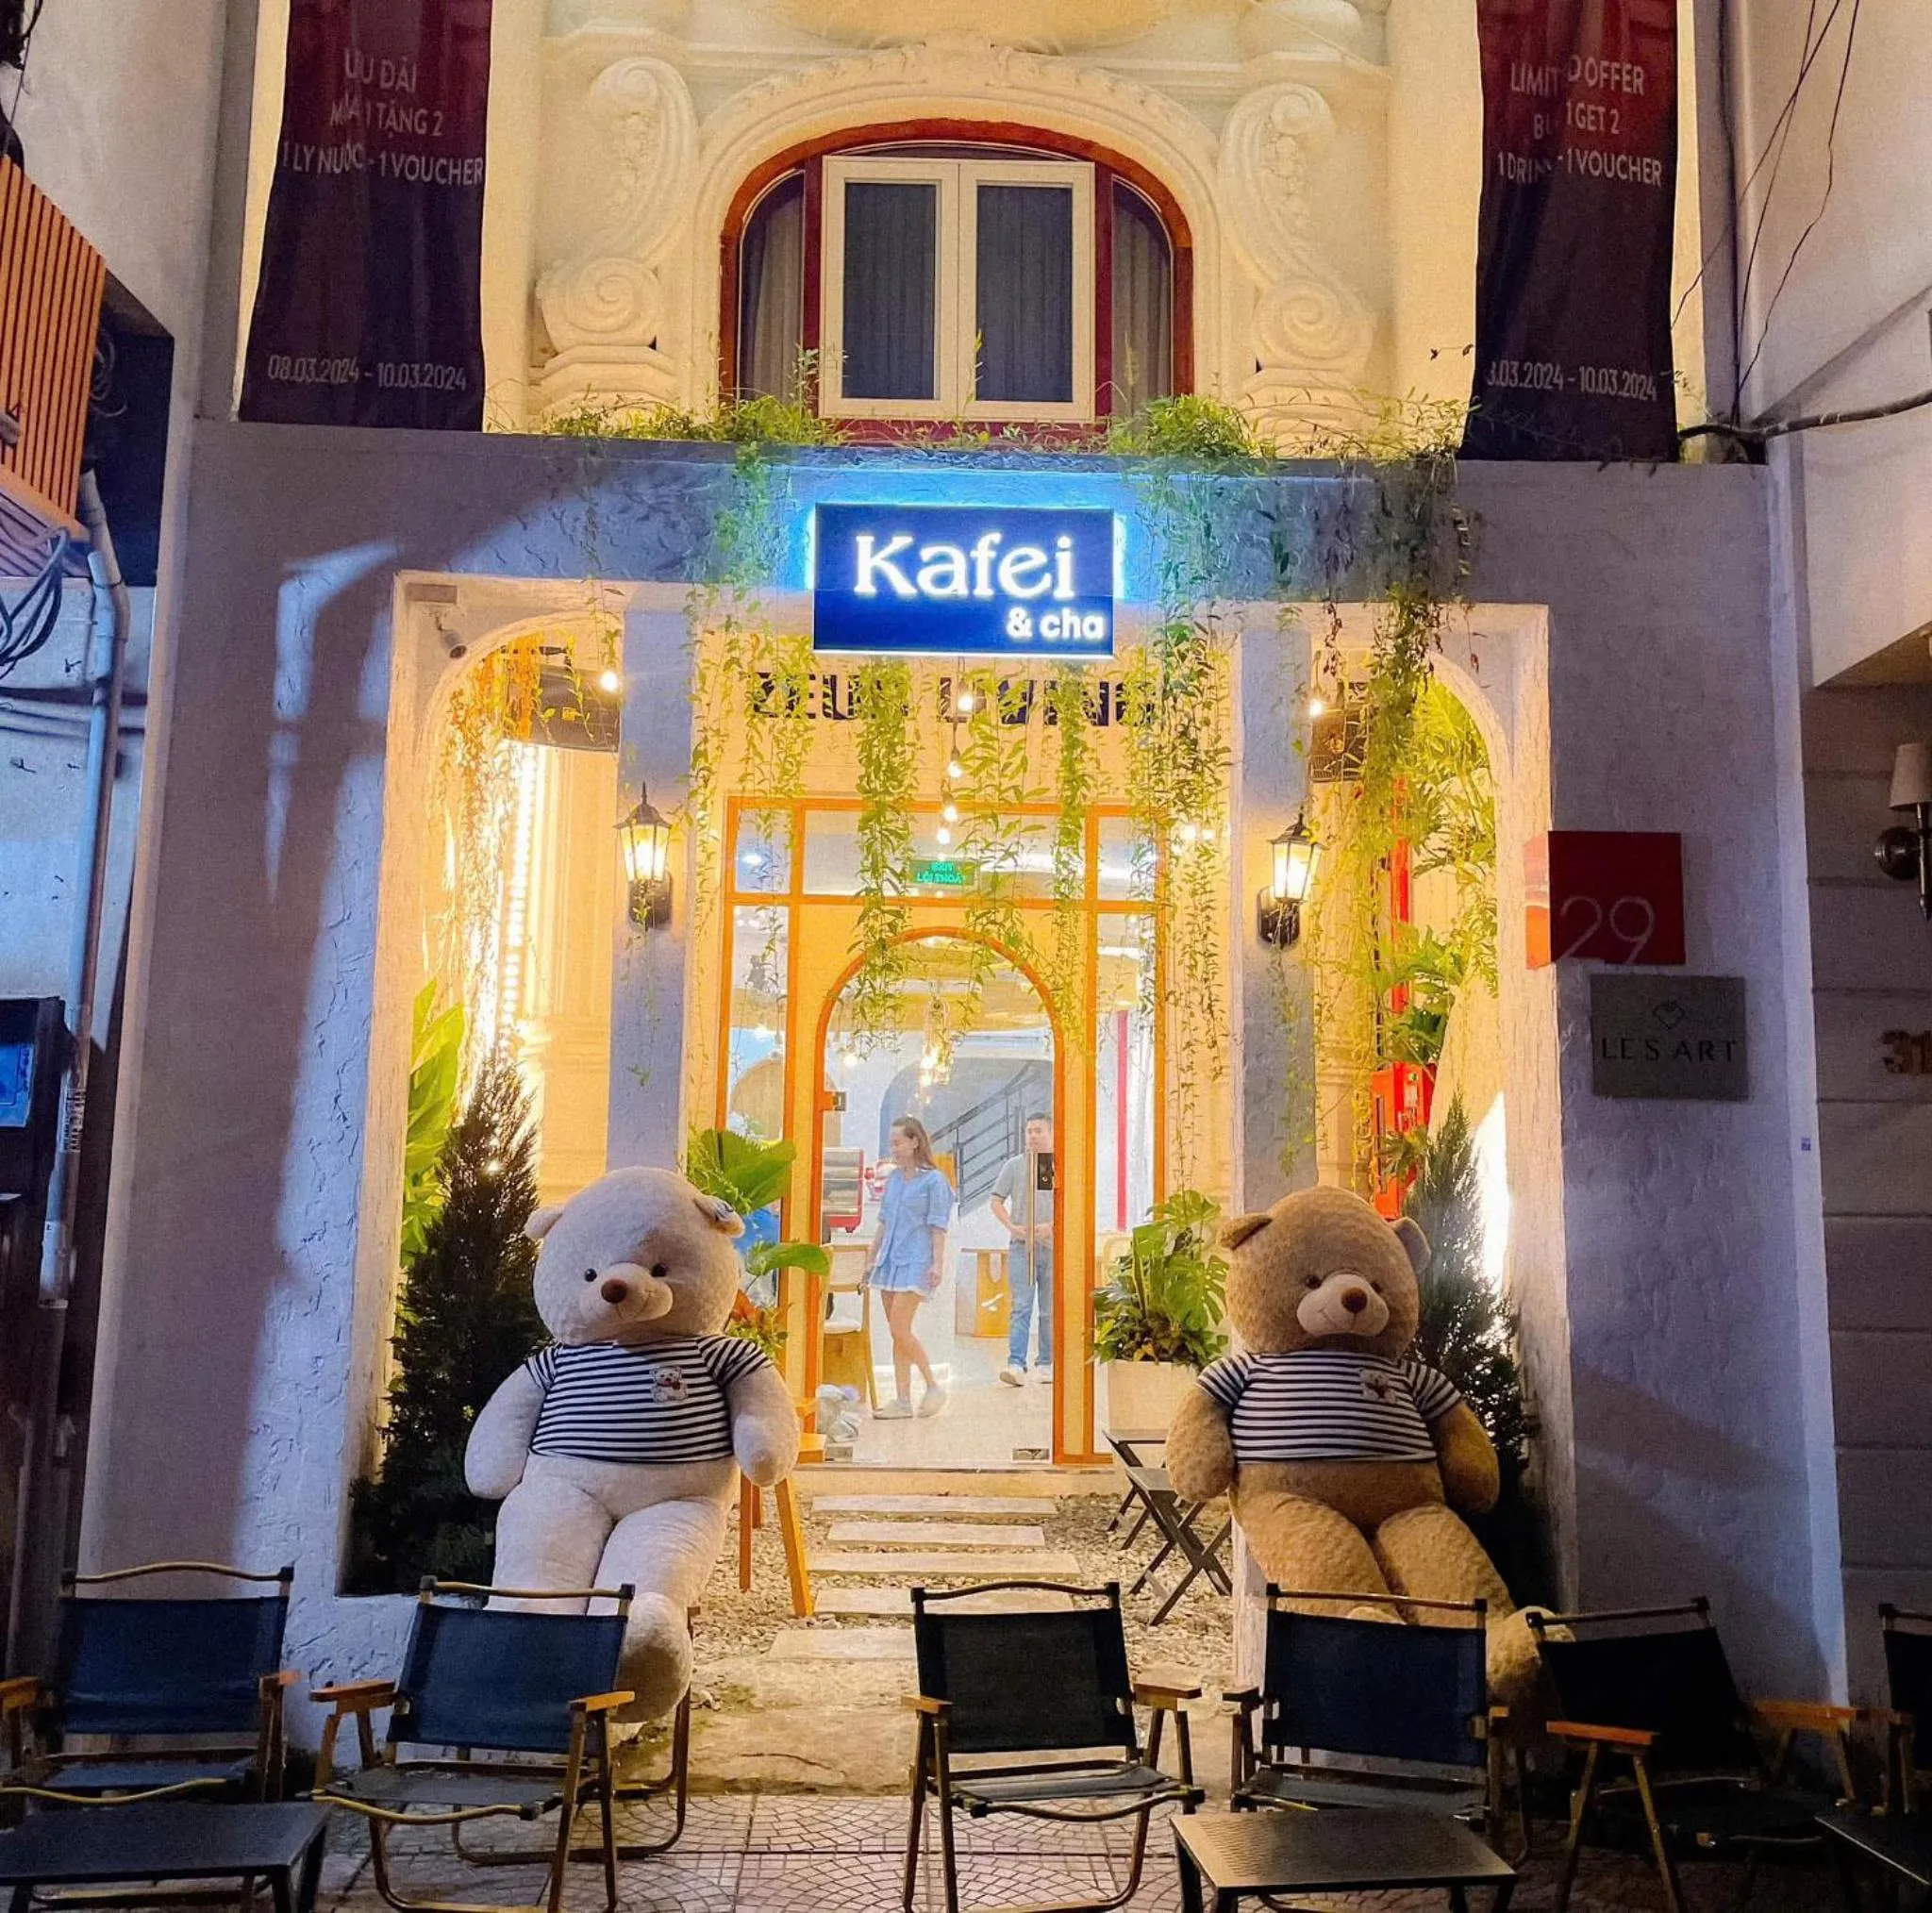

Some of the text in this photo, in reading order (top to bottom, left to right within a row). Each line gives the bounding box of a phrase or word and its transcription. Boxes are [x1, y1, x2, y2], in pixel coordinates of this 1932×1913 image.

[1510, 54, 1644, 96] LIMITD OFFER
[432, 110, 443, 137] 2
[1566, 99, 1572, 125] 1
[1574, 101, 1606, 131] GET
[1609, 108, 1620, 135] 2
[292, 143, 316, 173] LY
[378, 150, 386, 176] 1
[391, 151, 484, 186] VOUCHER
[1498, 150, 1505, 176] 1
[1566, 146, 1572, 175] 1
[1574, 147, 1663, 189] VOUCHER
[268, 355, 359, 384] 08.03.2024
[377, 361, 467, 391] 10.03.2024
[1579, 365, 1657, 402] 10.03.2024
[853, 532, 1075, 599] Kafei
[1006, 607, 1106, 640] & cha
[1559, 895, 1655, 965] 29
[1673, 1039, 1738, 1063] ART
